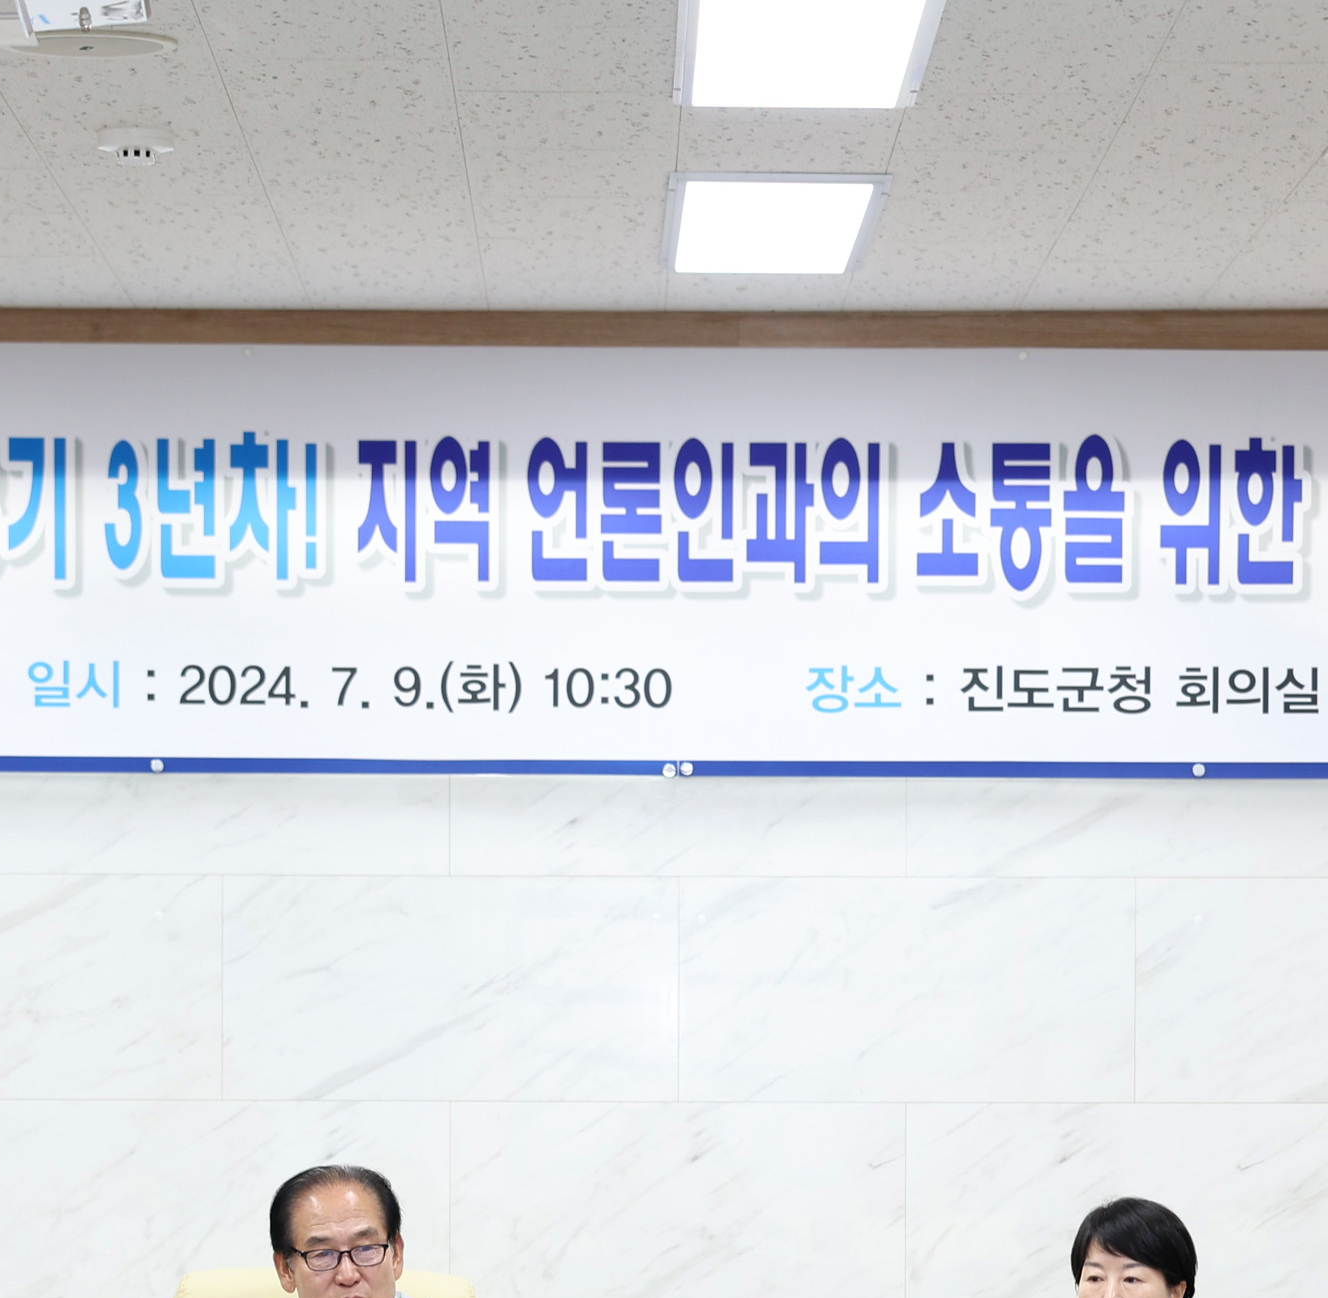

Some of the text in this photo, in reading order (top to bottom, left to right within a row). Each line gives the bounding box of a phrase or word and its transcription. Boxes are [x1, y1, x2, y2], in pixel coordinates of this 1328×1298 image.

[103, 430, 320, 582] 3년차!
[357, 435, 491, 583] 지역
[527, 436, 881, 584] 언론인과의
[916, 433, 1126, 591] 소통을
[1159, 436, 1304, 586] 위한
[26, 658, 673, 714] 일시 : 2024. 7. 9.(화) 10:30
[804, 663, 1321, 715] 장소 : 진도군청 회의실
